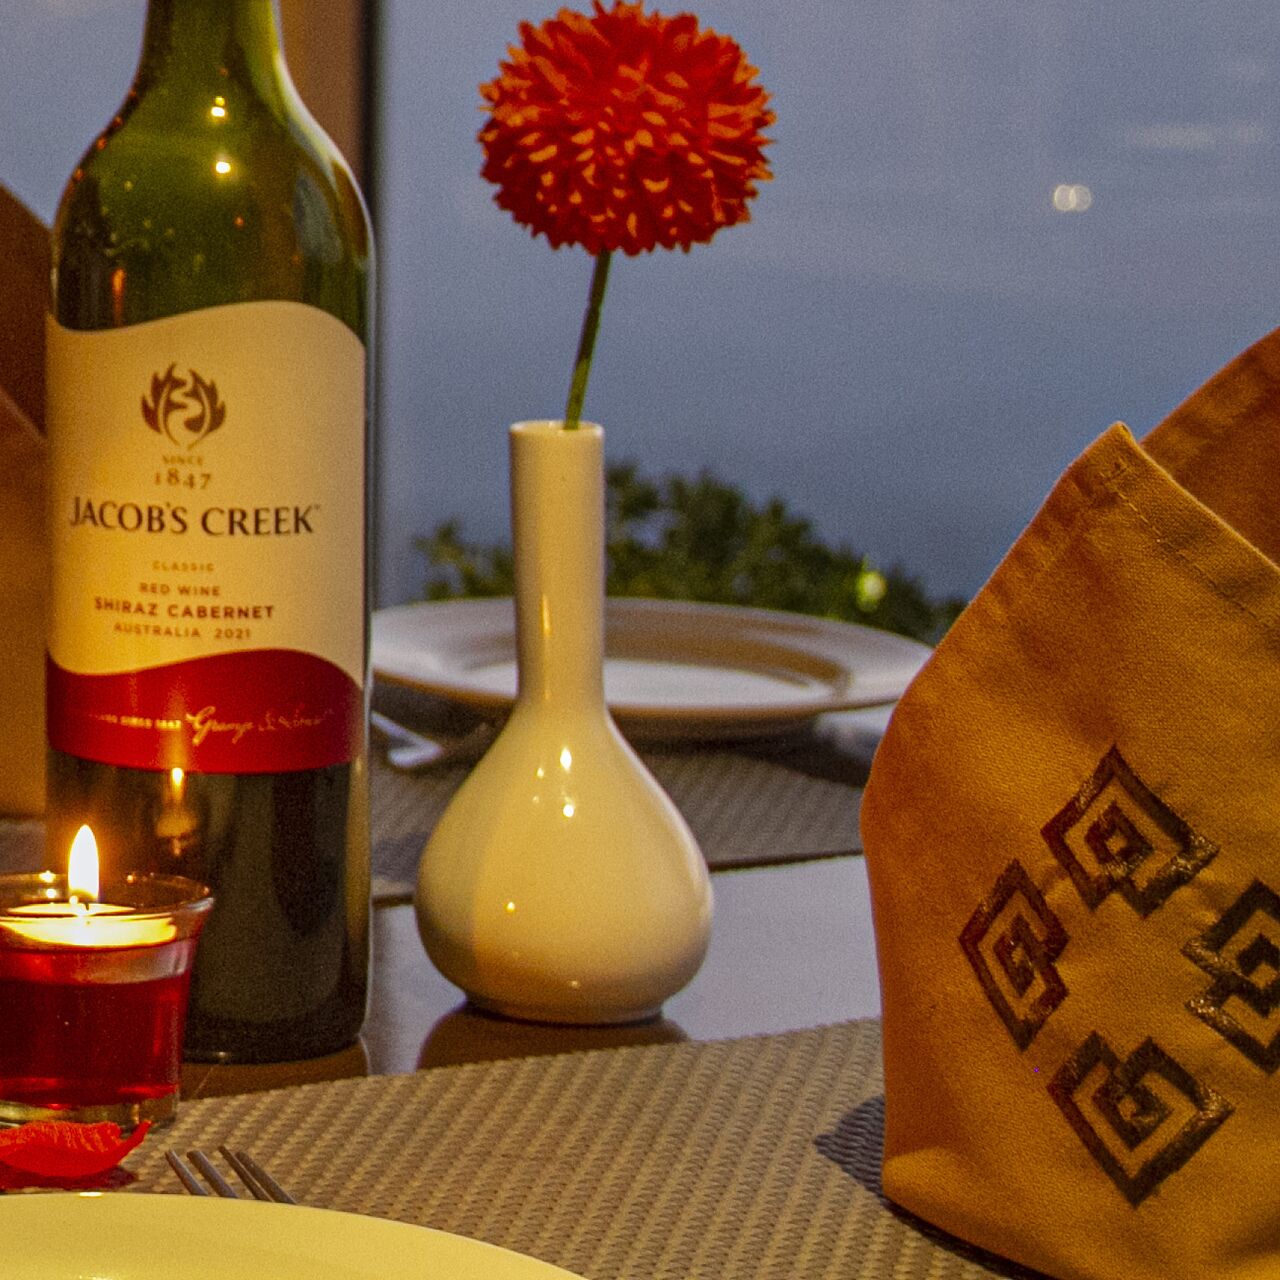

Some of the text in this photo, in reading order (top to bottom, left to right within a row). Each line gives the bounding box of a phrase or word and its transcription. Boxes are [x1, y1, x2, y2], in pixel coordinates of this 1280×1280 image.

[155, 468, 211, 489] 1847
[69, 497, 314, 536] JACOB'S CREEK
[152, 561, 215, 572] CLASSIC
[140, 583, 221, 596] RED WINE
[95, 597, 274, 619] SHIRAZ CABERNET
[113, 622, 251, 639] AUSTRALIA 2021
